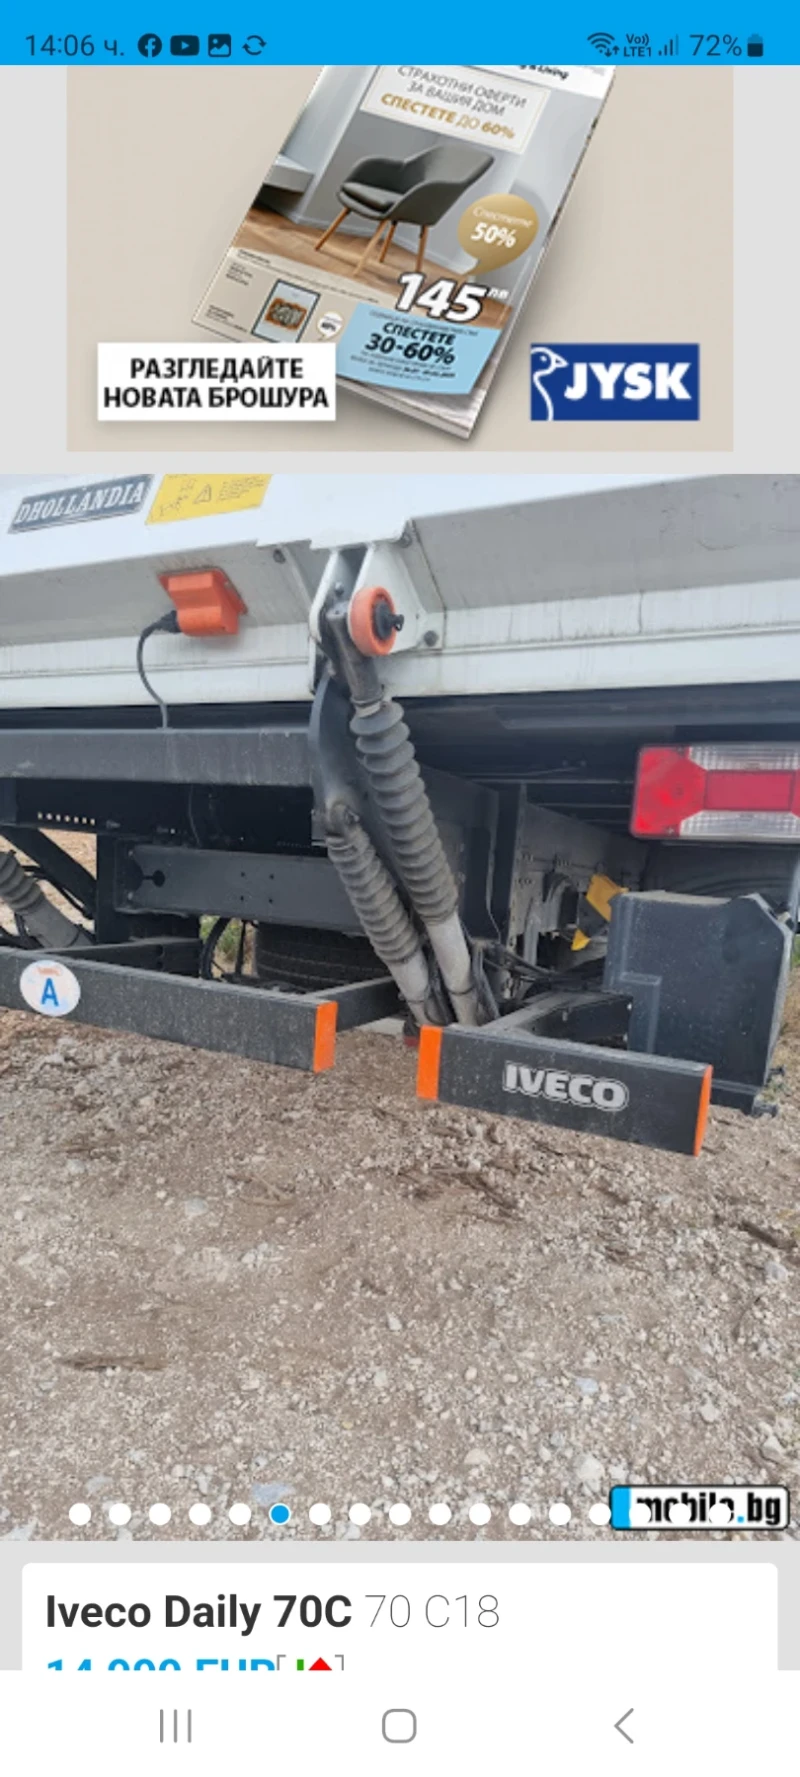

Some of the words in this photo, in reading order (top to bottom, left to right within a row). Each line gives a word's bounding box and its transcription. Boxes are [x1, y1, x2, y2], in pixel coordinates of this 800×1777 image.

[25, 34, 95, 56] 14:06
[104, 39, 125, 56] ч.
[689, 34, 742, 57] 72%
[398, 64, 475, 92] СТРАХОТНИ
[474, 86, 527, 108] ОФЕРТИ
[407, 80, 425, 95] ЗА
[426, 86, 472, 107] ВАШИЯ
[471, 99, 506, 116] ДОМ
[380, 92, 456, 123] СПЕСТЕТЕ
[455, 112, 481, 130] ДО
[481, 120, 515, 140] 60%
[470, 221, 517, 249] 50%
[396, 271, 488, 323] 145
[365, 333, 456, 365] 30-60%
[382, 321, 456, 346] СПЕСТЕТЕ
[130, 355, 304, 383] РАЗГЛЕДАЙТЕ
[563, 361, 692, 401] JYSK
[103, 386, 203, 408] НОВАТА
[208, 386, 330, 408] БРОШУРА
[14, 481, 145, 525] DHOLLANDIA
[40, 977, 59, 1007] A
[503, 1061, 629, 1112] IVECO
[47, 1595, 151, 1628] Iveco
[165, 1594, 262, 1637] Daily
[273, 1594, 352, 1628] 70C
[364, 1594, 411, 1628] 70
[425, 1594, 499, 1628] C18
